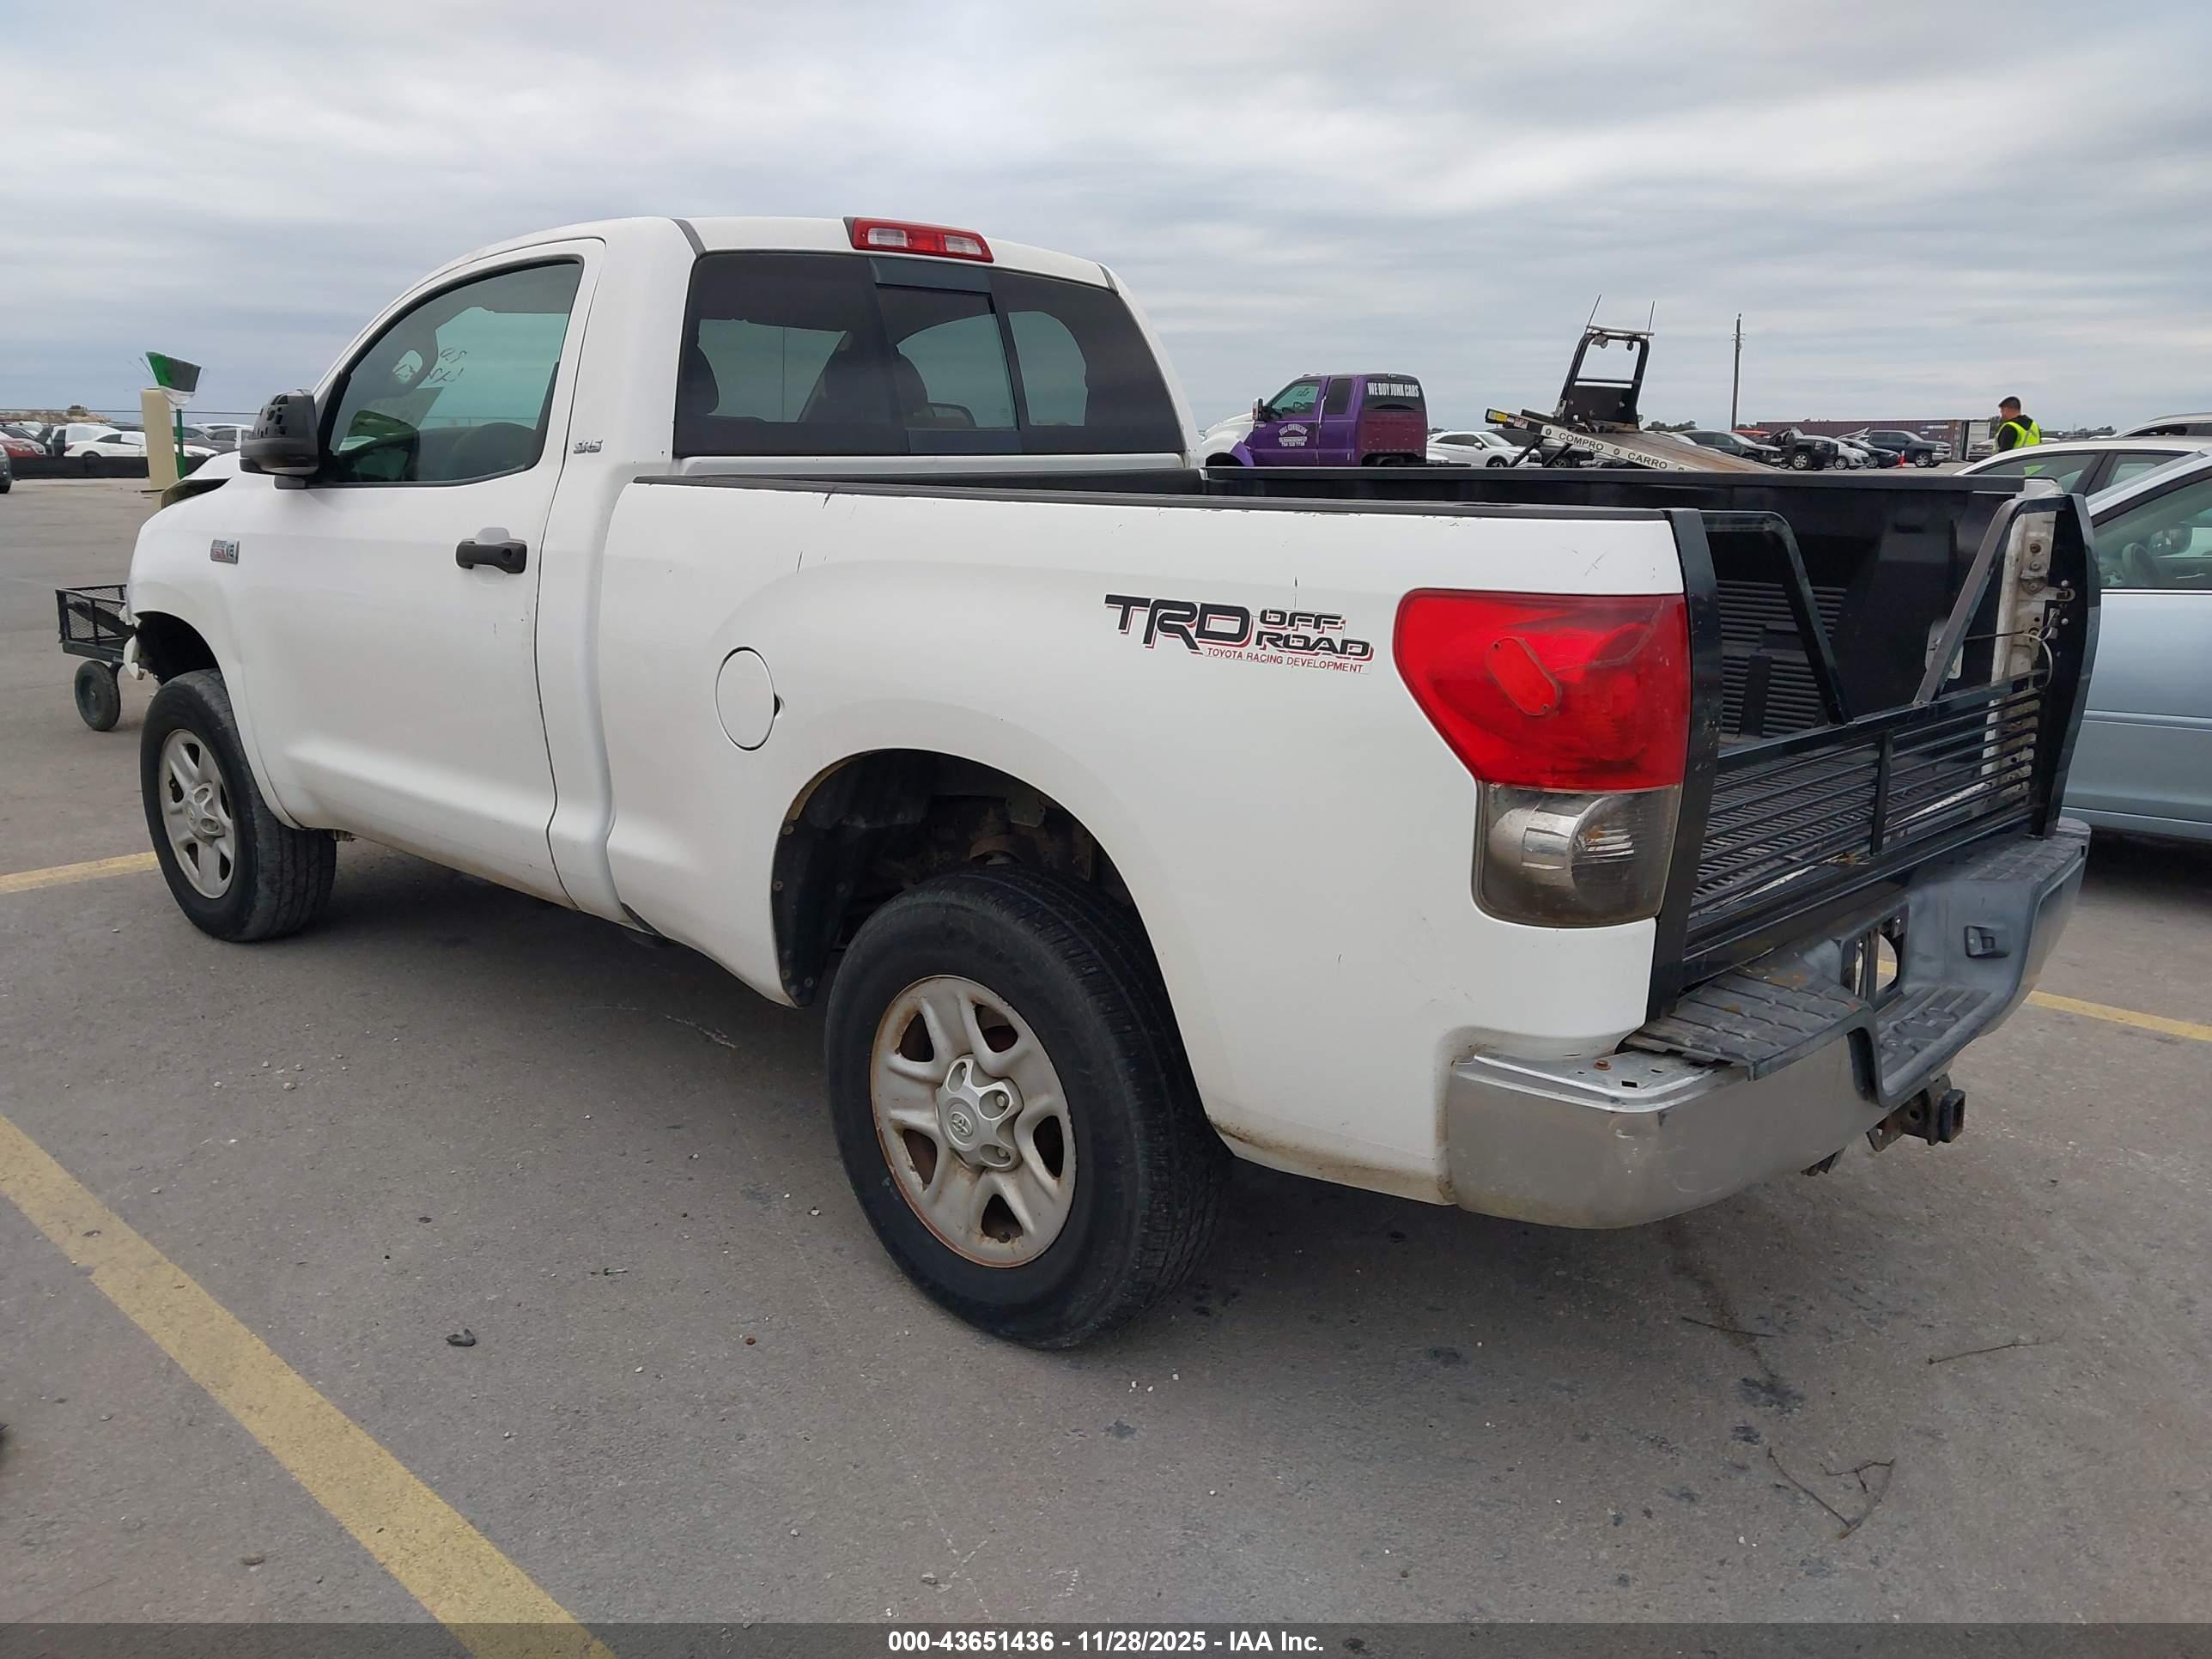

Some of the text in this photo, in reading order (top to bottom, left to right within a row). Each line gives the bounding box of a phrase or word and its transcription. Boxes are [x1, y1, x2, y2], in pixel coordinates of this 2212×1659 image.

[1367, 382, 1378, 396] WE
[1378, 382, 1389, 396] BUY
[1404, 384, 1419, 398] CARS
[1559, 432, 1668, 470] COMPRO CARRO
[1104, 594, 1253, 655] TRD
[1259, 608, 1346, 633] OFF
[1255, 631, 1374, 661] ROAD
[1206, 647, 1364, 674] TOYOTA RACING DEVELOPMENT
